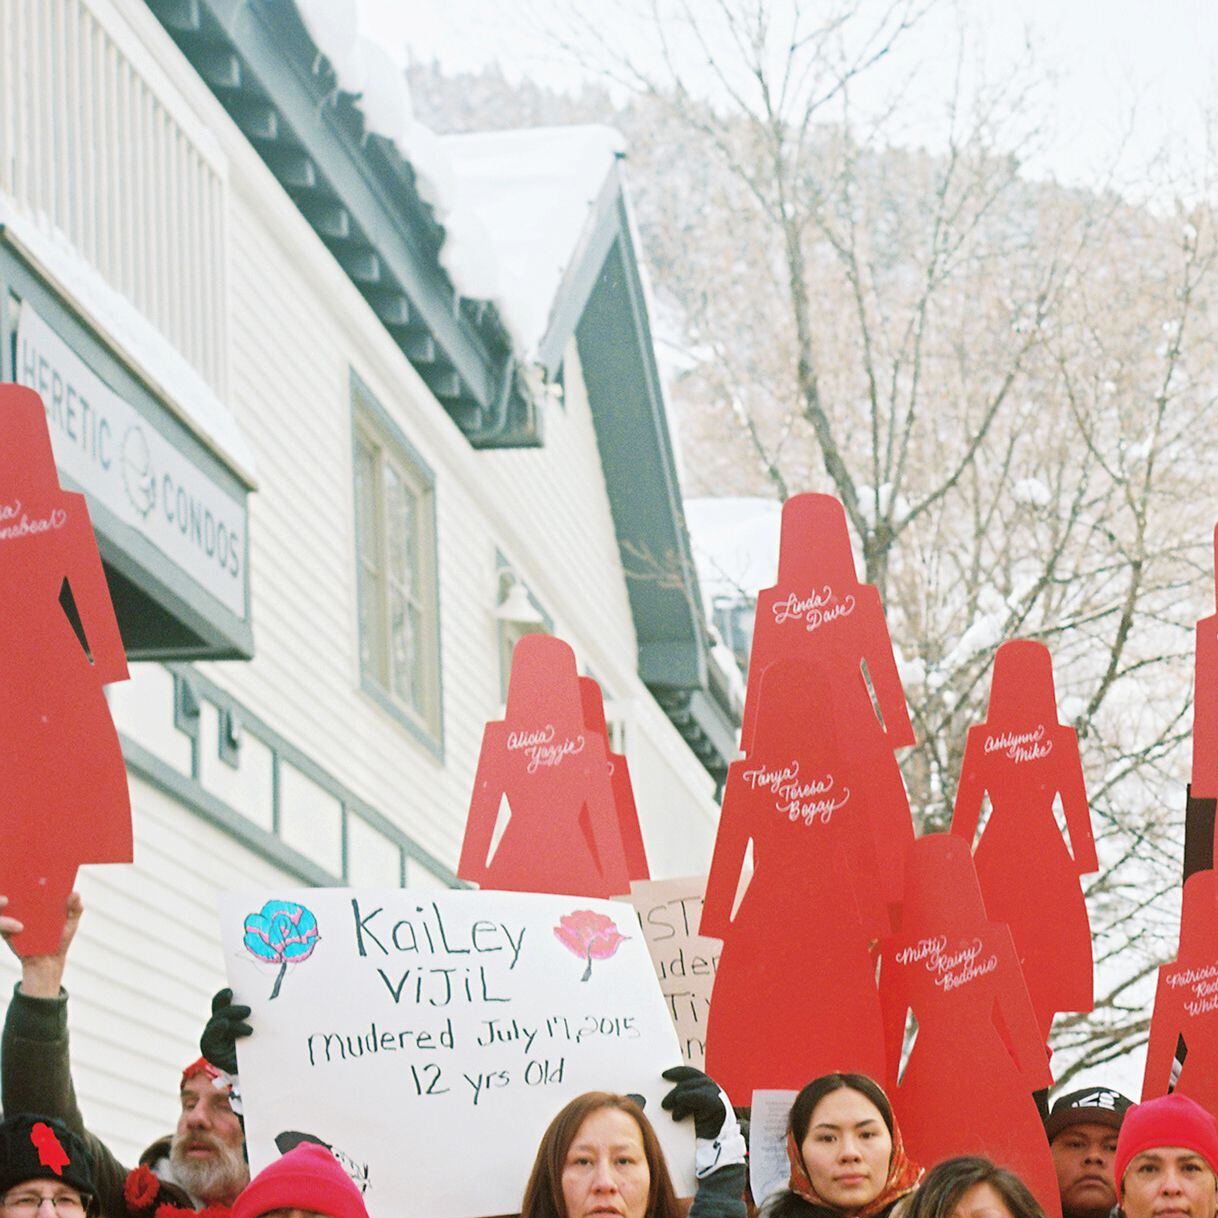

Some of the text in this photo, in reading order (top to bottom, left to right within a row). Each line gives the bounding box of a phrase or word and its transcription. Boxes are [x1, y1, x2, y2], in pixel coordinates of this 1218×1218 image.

[23, 340, 239, 577] HERETIC CONDOS
[772, 585, 832, 624] Linda
[743, 760, 799, 793] Tanya
[477, 1018, 538, 1054] July
[411, 1063, 449, 1097] 12
[463, 1066, 511, 1105] yrs
